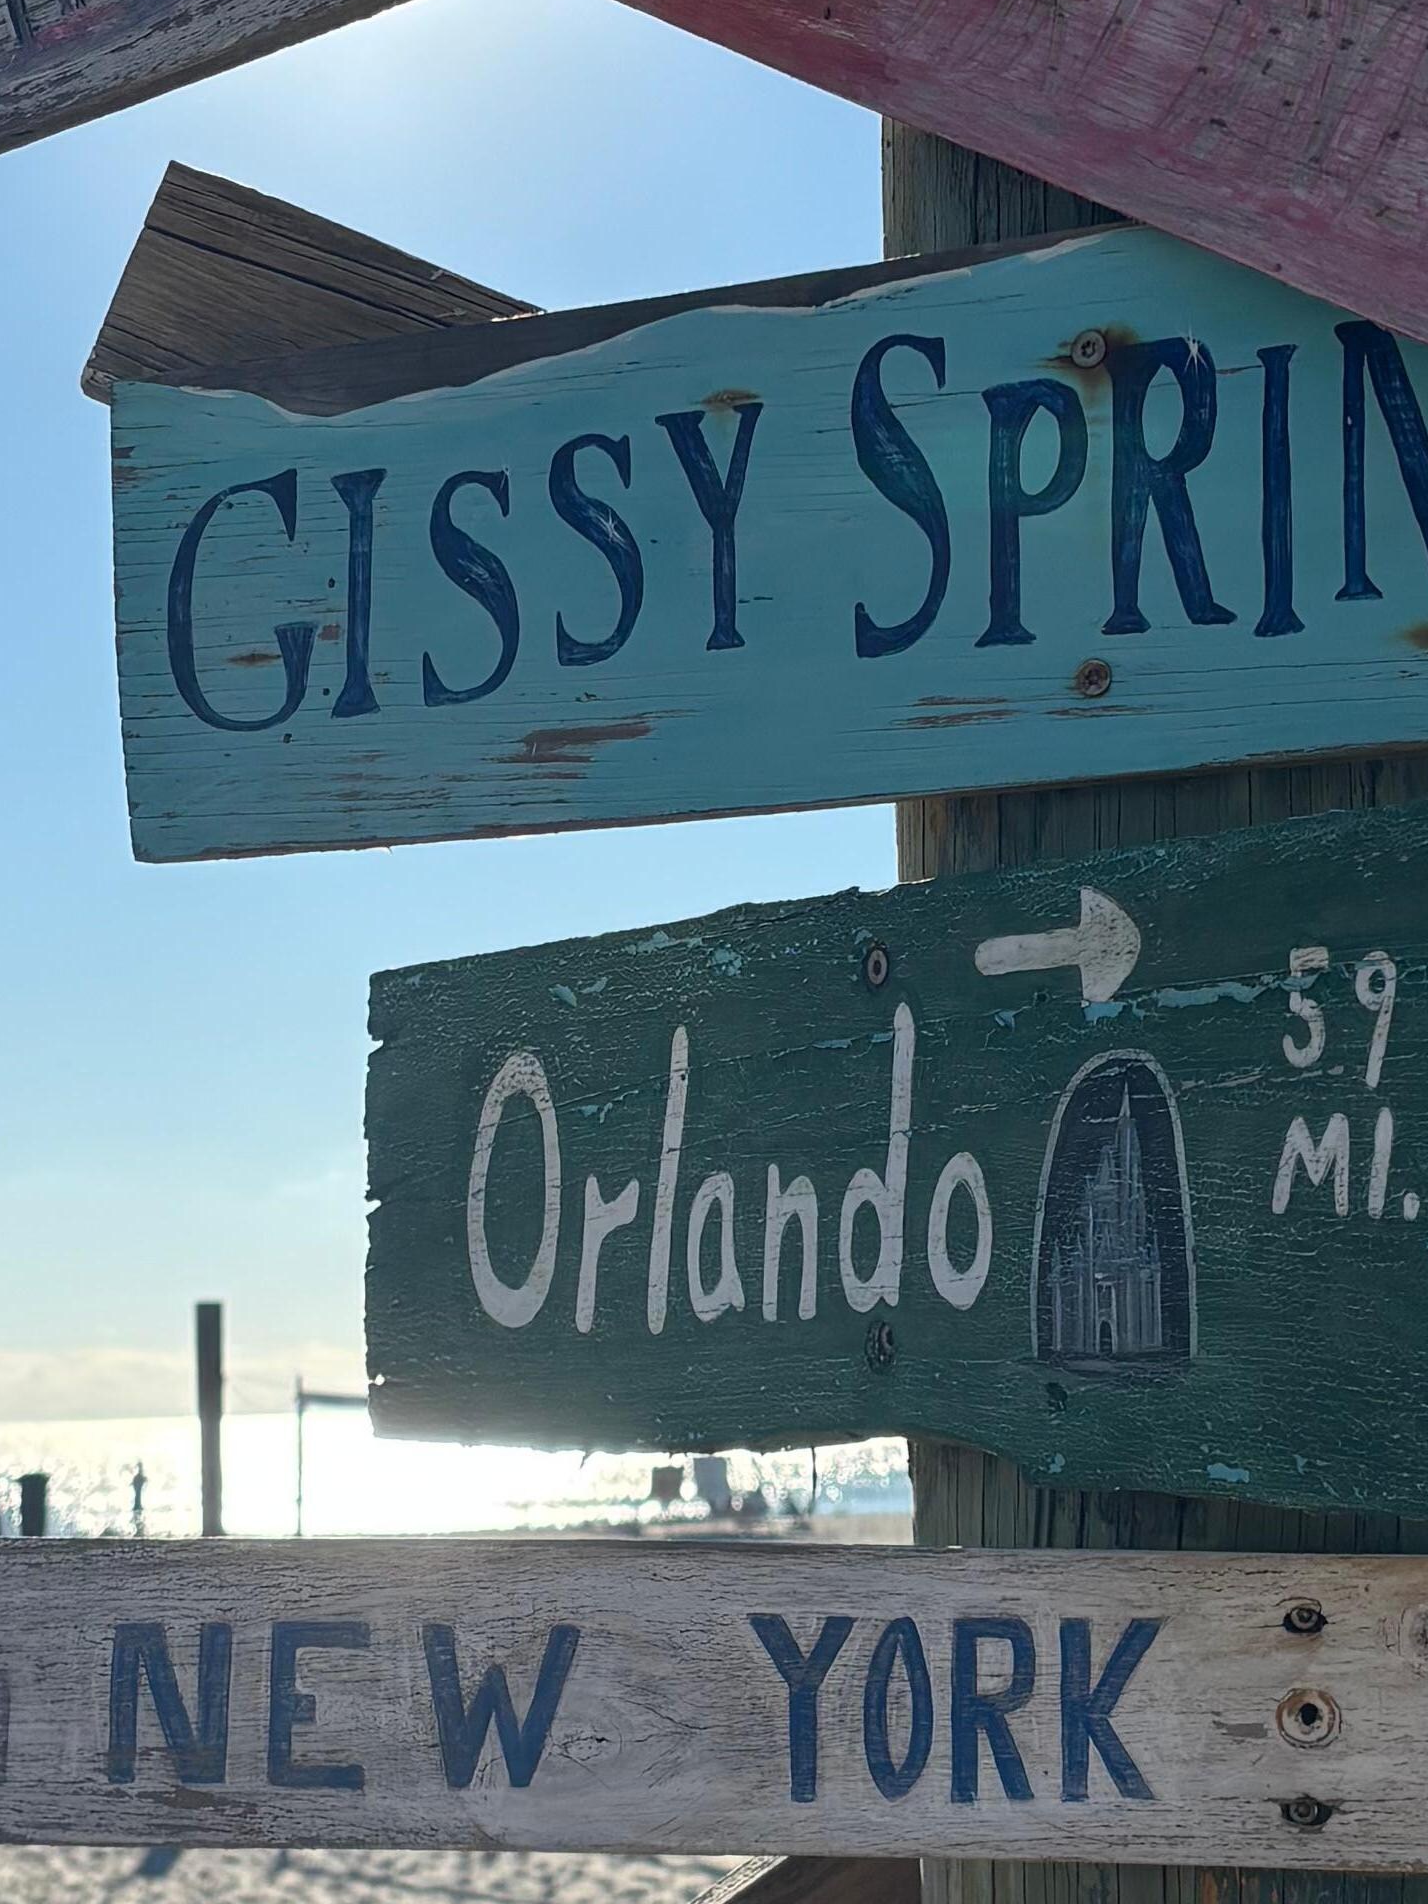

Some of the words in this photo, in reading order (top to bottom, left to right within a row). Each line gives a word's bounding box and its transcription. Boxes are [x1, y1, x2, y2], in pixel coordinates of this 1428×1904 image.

[168, 396, 766, 732] GISSY
[1281, 945, 1398, 1088] 59
[466, 1001, 994, 1336] Orlando
[1271, 1104, 1422, 1220] MI.
[105, 1618, 582, 1793] NEW
[747, 1613, 1168, 1805] YORK
